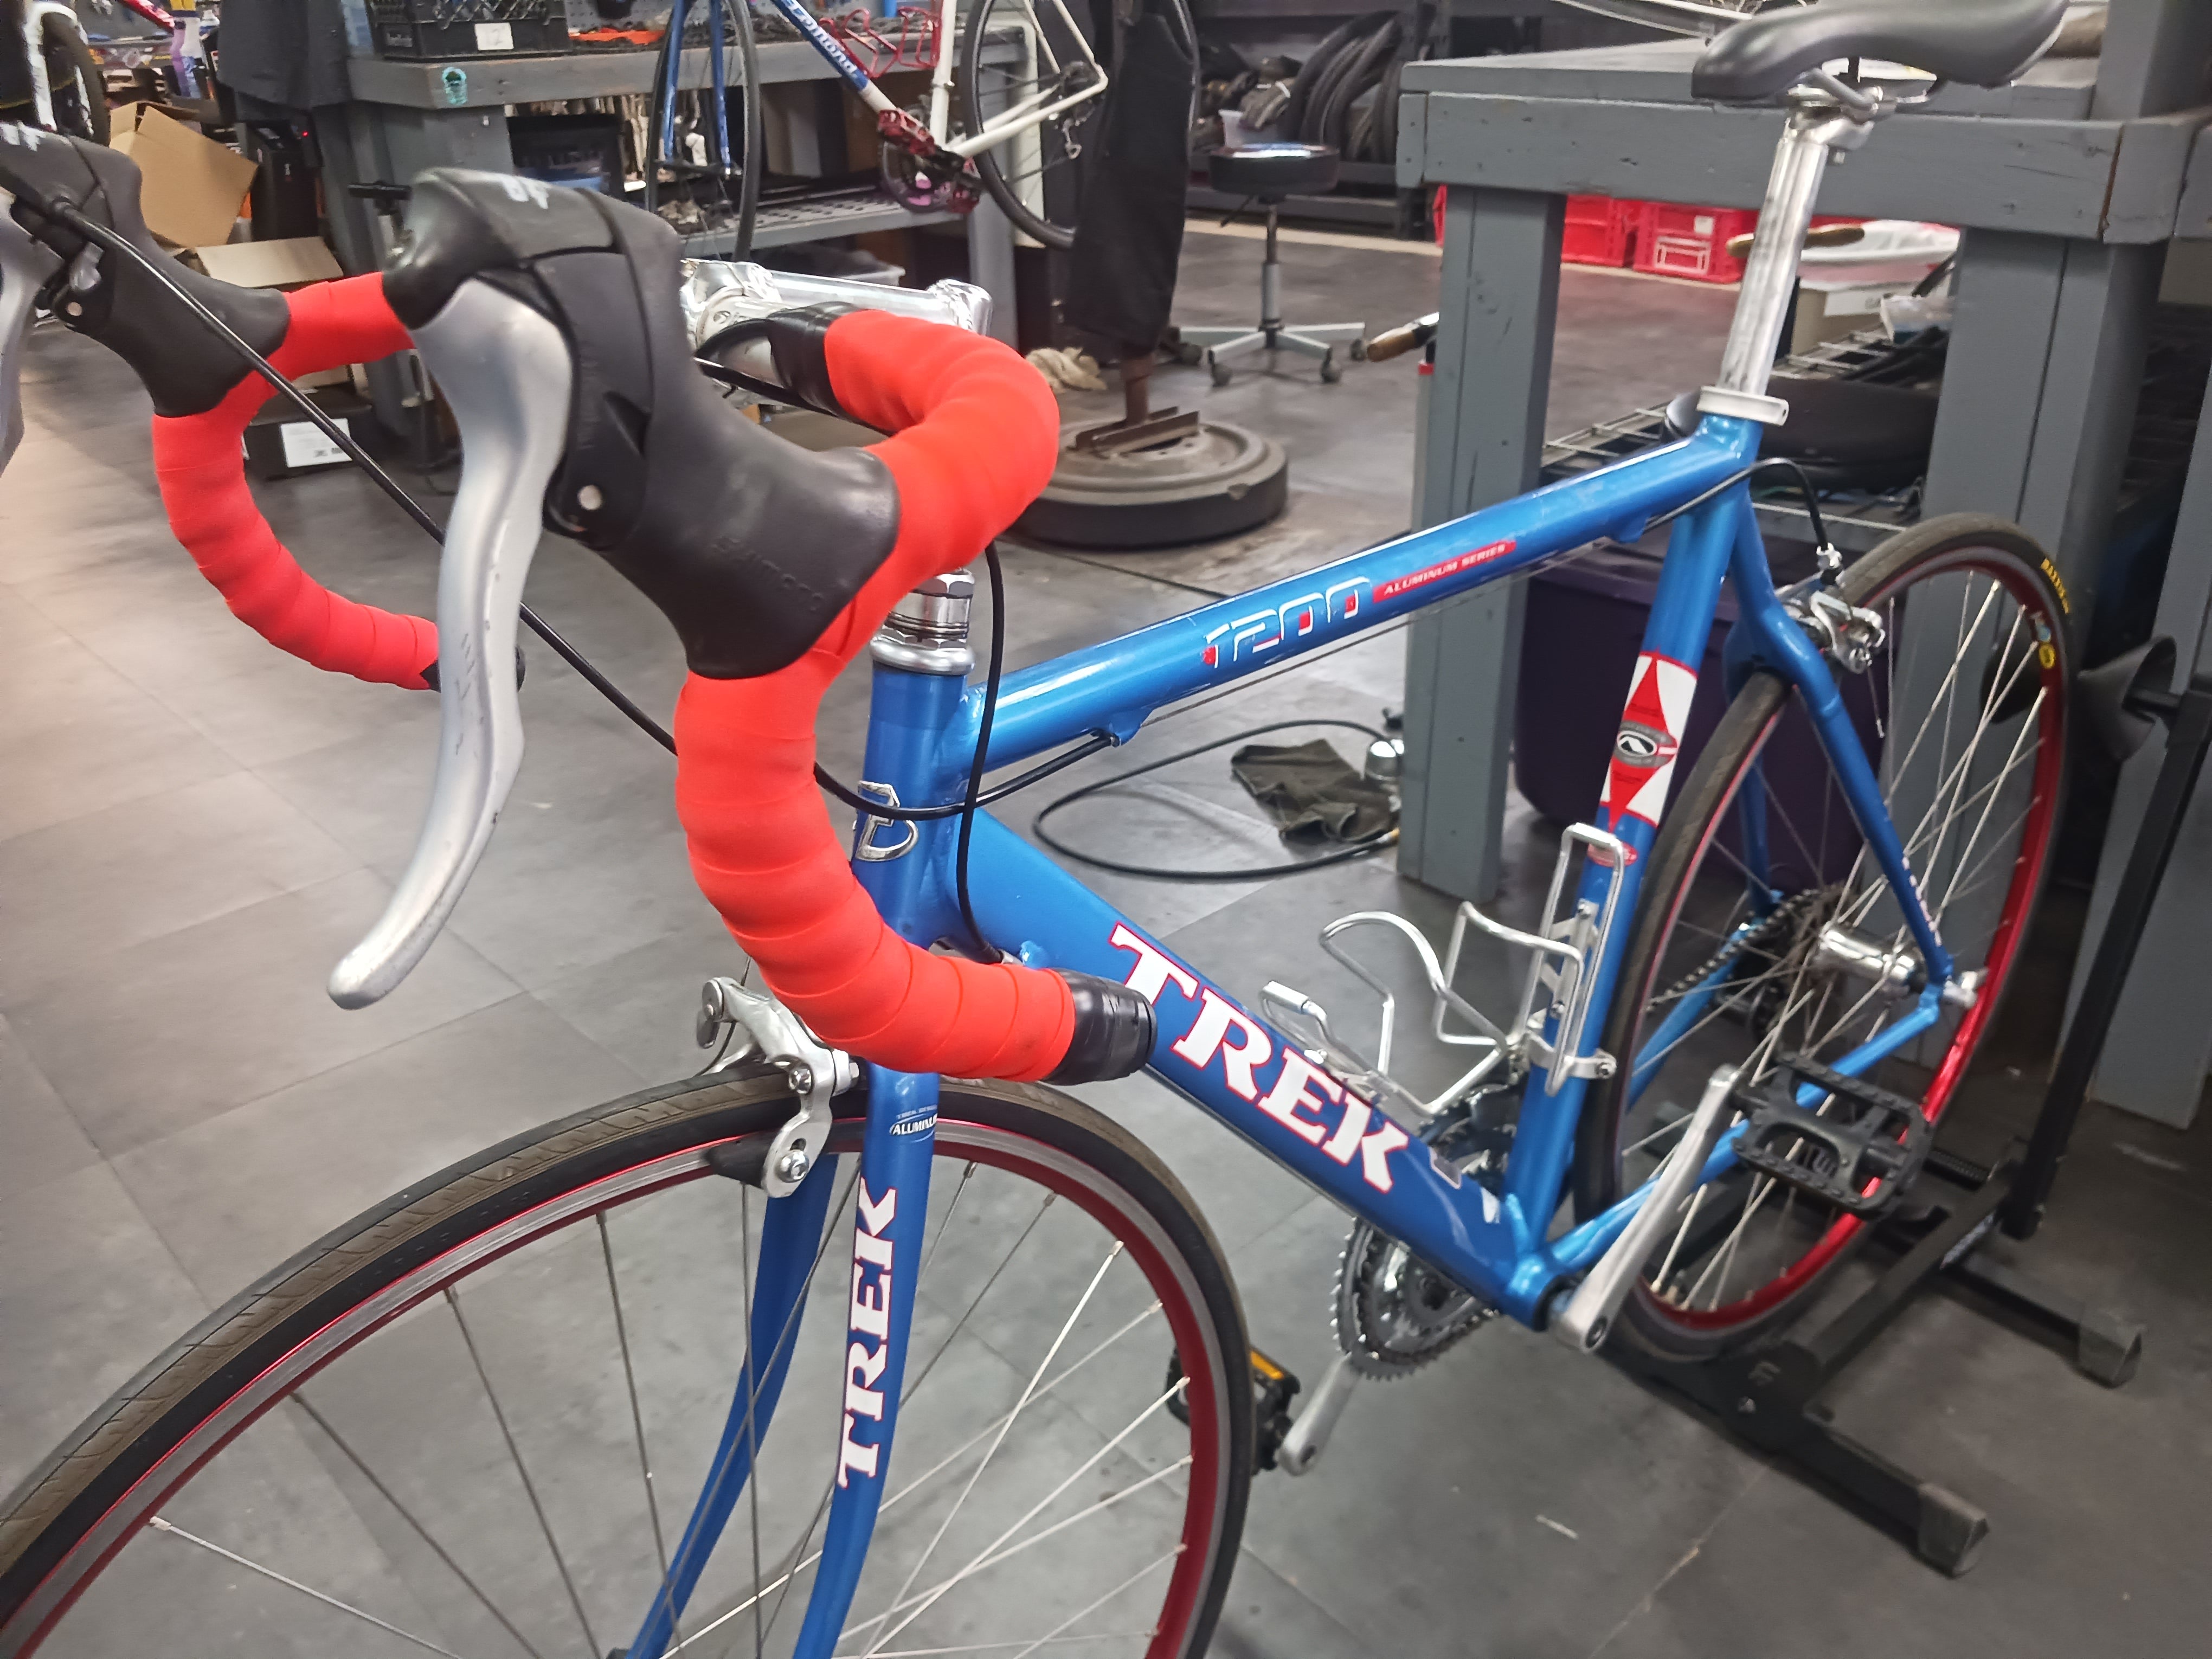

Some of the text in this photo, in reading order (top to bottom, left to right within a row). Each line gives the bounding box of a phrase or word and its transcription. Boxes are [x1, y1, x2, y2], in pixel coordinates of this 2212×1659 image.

[1384, 544, 1506, 596] ALUMINUM SERIES
[1202, 576, 1371, 668] 1200
[1109, 921, 1409, 1194] TREK
[892, 1113, 938, 1135] ALUMINU
[838, 1176, 897, 1489] TREK
